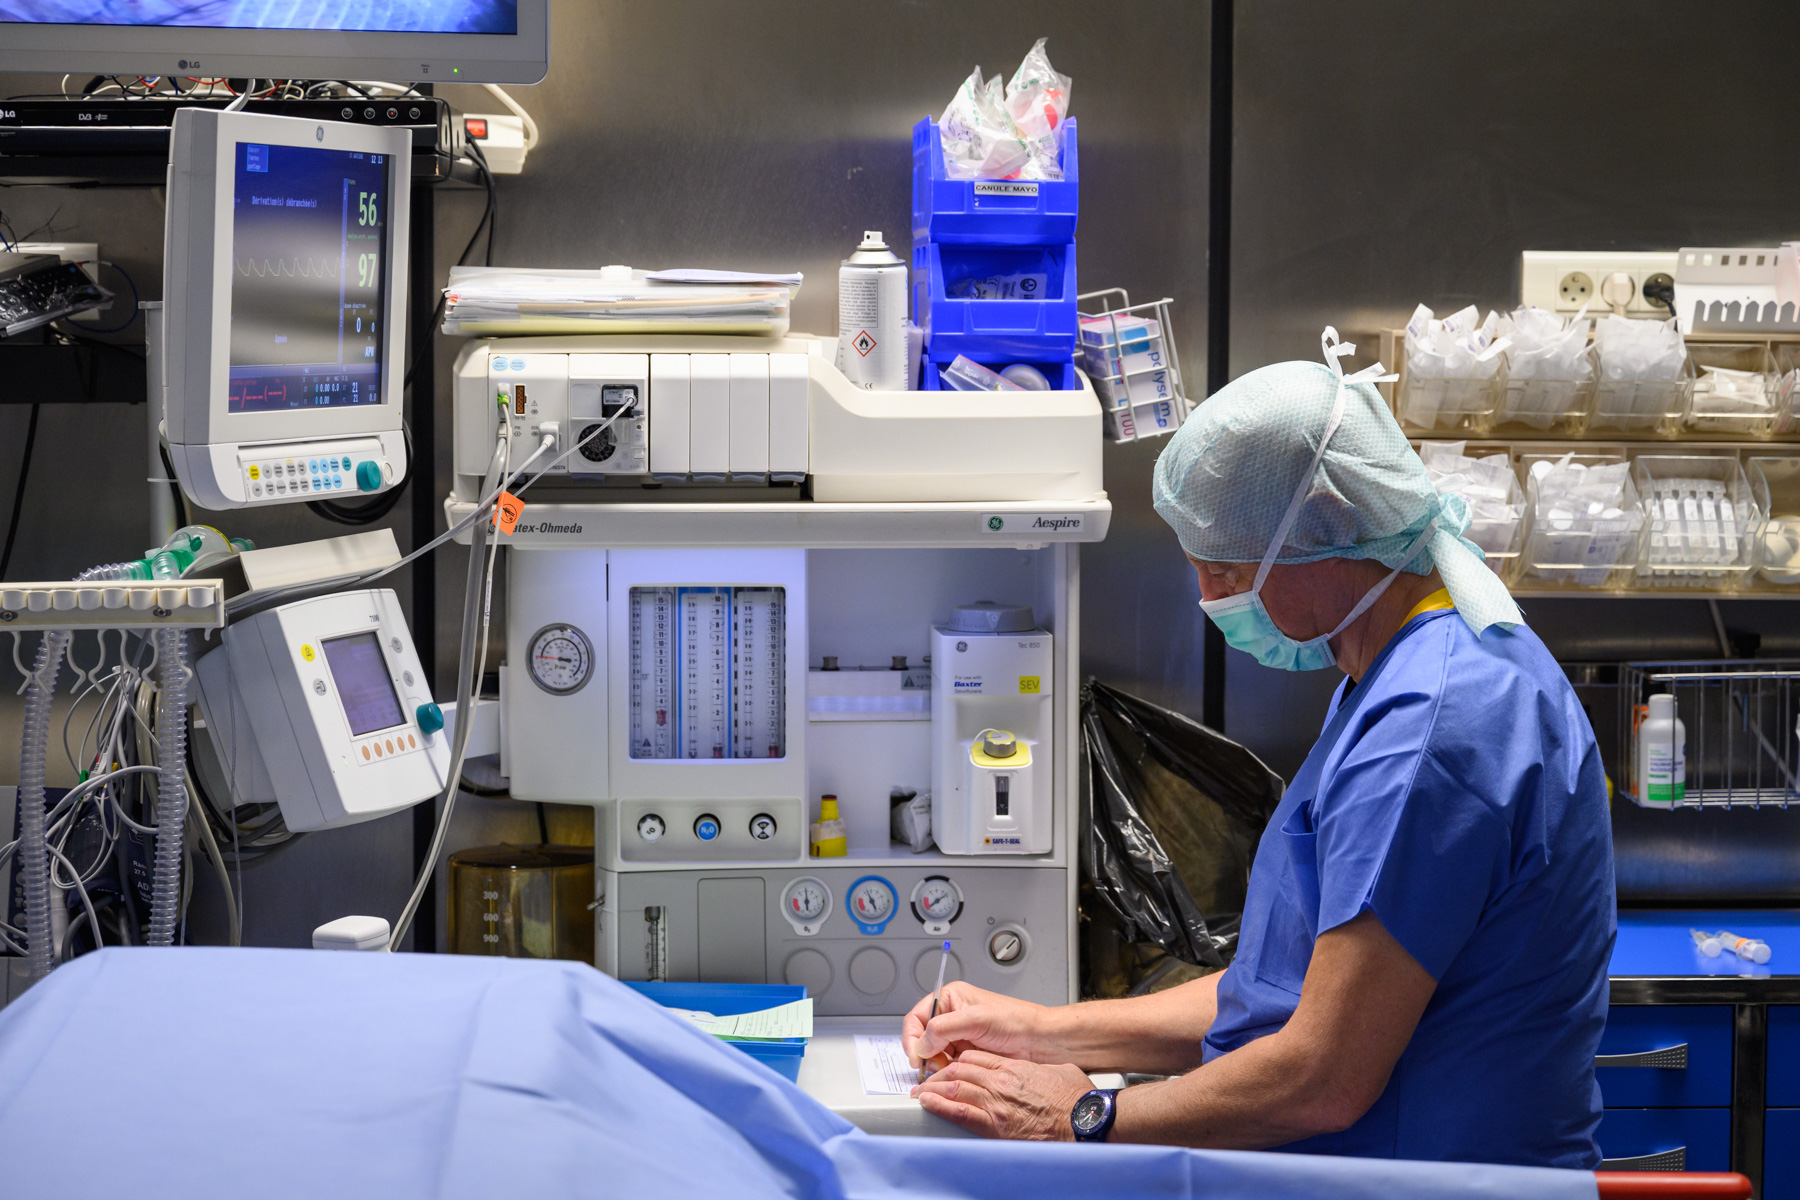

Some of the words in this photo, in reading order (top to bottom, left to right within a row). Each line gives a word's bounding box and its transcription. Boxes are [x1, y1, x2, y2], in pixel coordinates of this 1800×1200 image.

[189, 61, 200, 69] LG
[4, 110, 16, 118] LG
[359, 192, 377, 226] 56
[359, 253, 376, 288] 97
[356, 317, 362, 333] 0
[352, 382, 358, 392] 21
[512, 522, 583, 534] atex-Ohmeda
[1032, 516, 1080, 531] Aespire
[1020, 680, 1040, 690] SEV
[483, 890, 498, 900] 300
[483, 912, 498, 922] 600
[483, 934, 499, 943] 900
